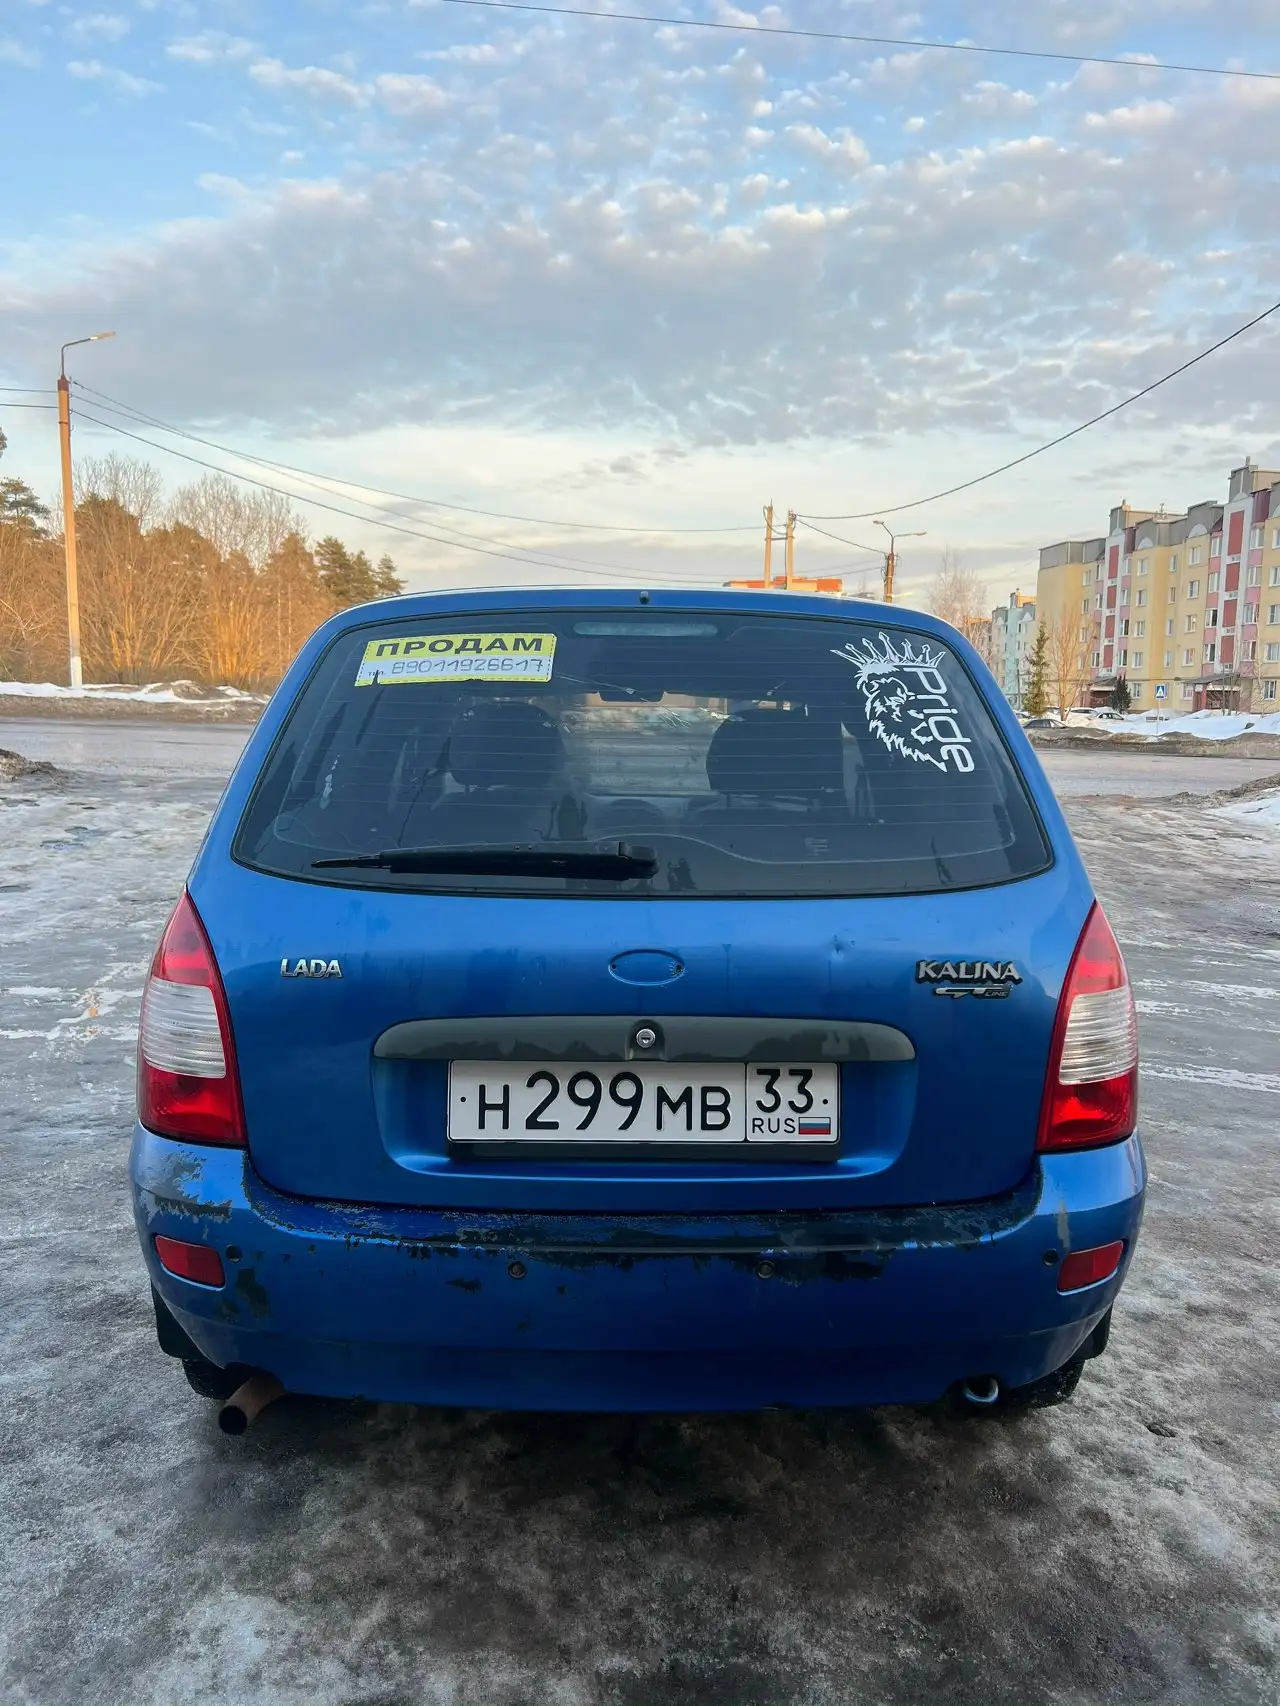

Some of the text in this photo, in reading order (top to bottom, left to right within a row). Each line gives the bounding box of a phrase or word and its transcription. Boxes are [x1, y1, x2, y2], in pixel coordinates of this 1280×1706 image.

[376, 637, 542, 656] ПРОДАМ
[391, 658, 543, 674] 89011926617
[903, 667, 975, 772] Pride
[281, 958, 342, 978] LADA
[917, 960, 1021, 981] KALINA
[478, 1071, 731, 1130] Н299МВ
[756, 1068, 814, 1113] 33
[752, 1117, 796, 1134] RUS
